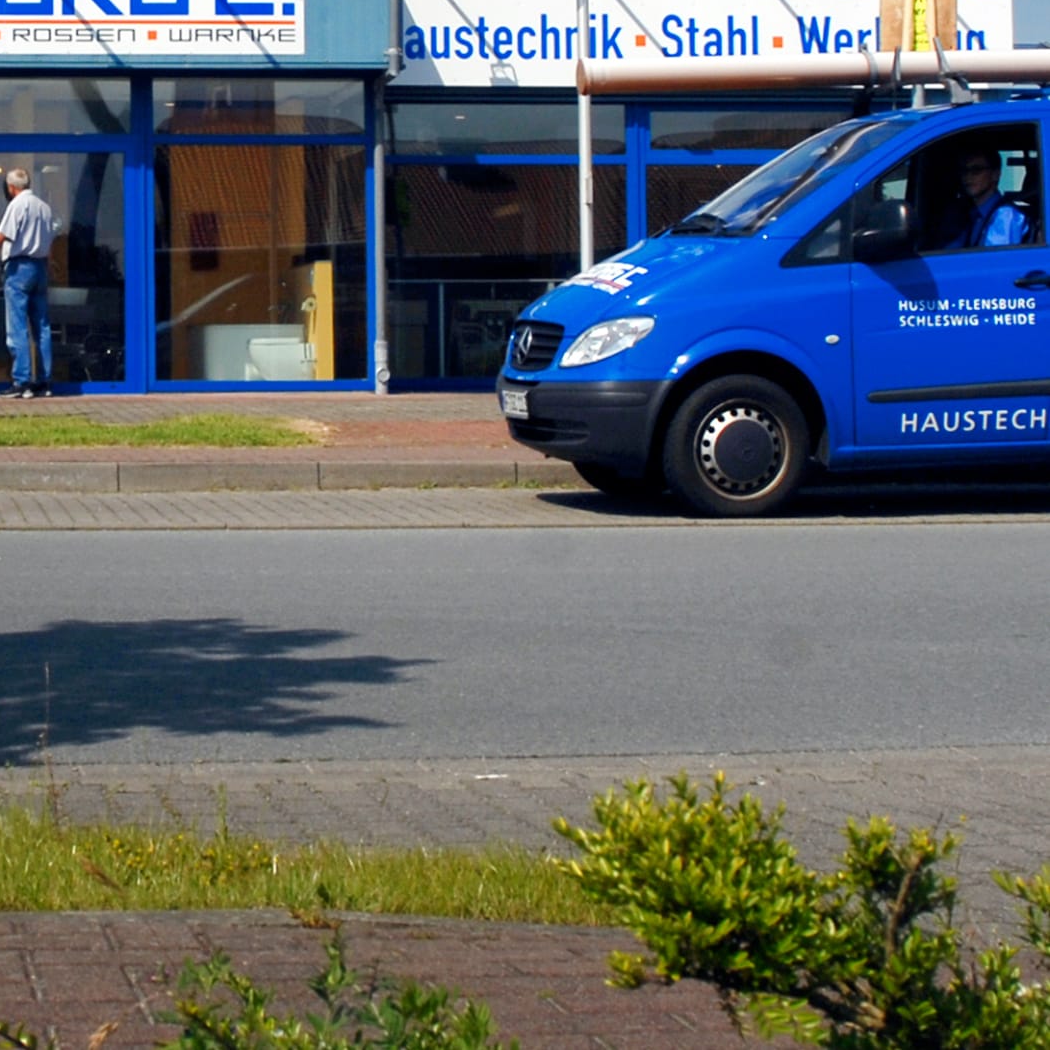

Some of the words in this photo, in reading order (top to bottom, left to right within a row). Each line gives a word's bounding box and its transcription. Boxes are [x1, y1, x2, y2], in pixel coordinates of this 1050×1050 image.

[12, 28, 136, 43] ROSSEN
[168, 28, 296, 43] WARNKE
[662, 14, 758, 57] Stahl
[899, 299, 949, 312] HUSUM
[958, 297, 1036, 311] FLENSBURG
[899, 314, 980, 328] SCHLESWIG
[993, 313, 1036, 326] HEIDE
[901, 408, 1047, 434] HAUSTECH
